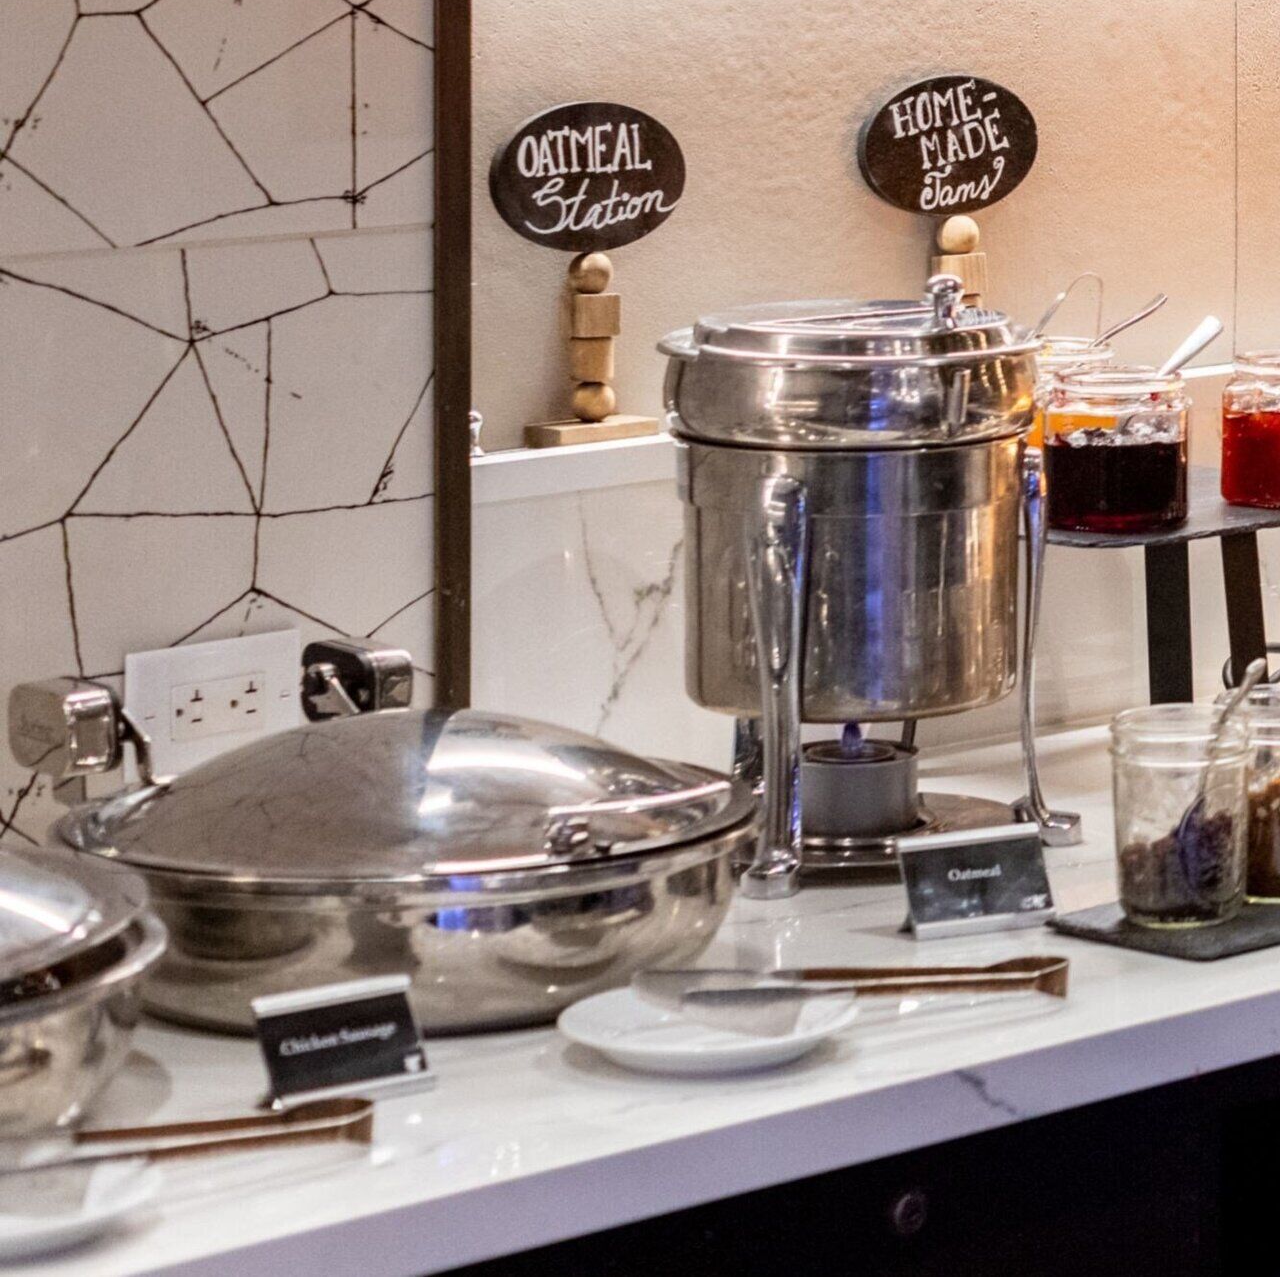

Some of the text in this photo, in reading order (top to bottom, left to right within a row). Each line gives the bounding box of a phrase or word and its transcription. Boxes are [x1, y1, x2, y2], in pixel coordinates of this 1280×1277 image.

[888, 77, 999, 140] HOME-
[516, 121, 653, 179] OATMEAL
[919, 109, 1011, 171] MADE
[523, 177, 678, 235] Station
[919, 155, 1006, 211] Jams
[946, 863, 1003, 882] Oatmeal
